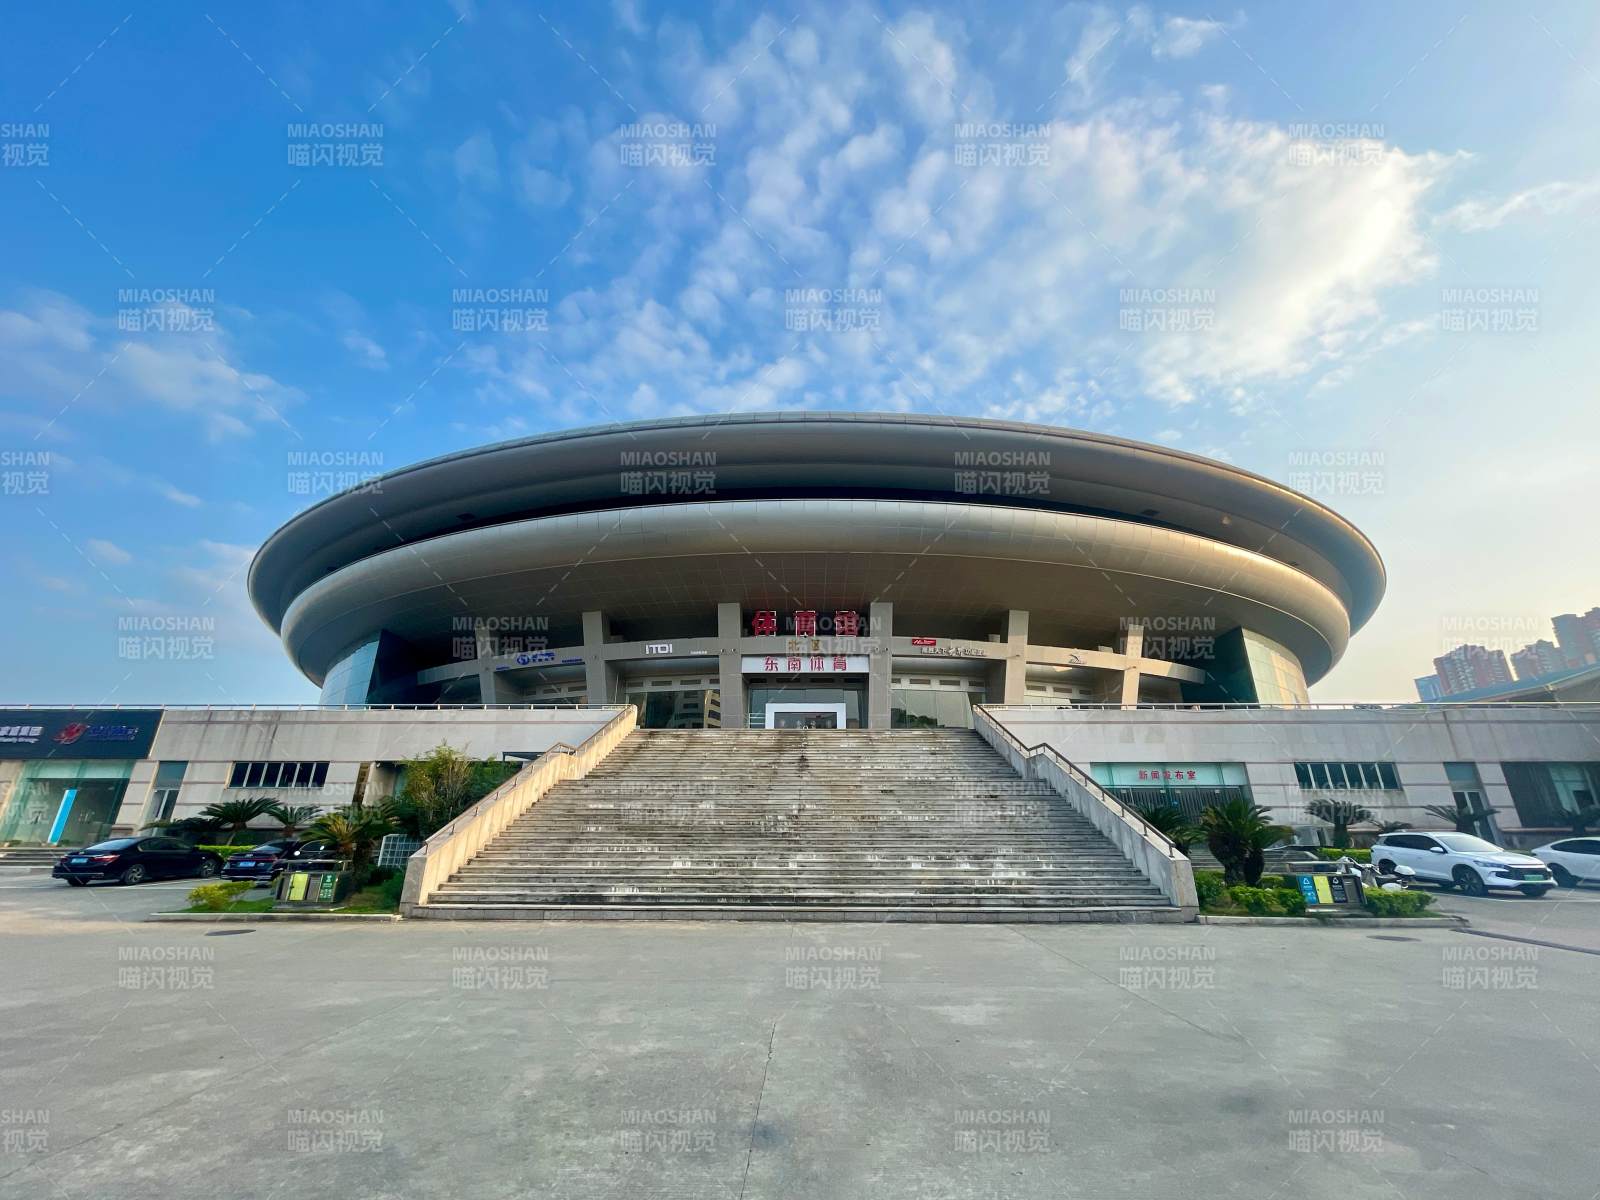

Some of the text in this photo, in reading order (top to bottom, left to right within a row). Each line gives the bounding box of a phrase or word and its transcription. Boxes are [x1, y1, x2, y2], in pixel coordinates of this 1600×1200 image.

[752, 610, 860, 636] 体育馆
[764, 656, 847, 671] 东南体育
[1138, 769, 1196, 780] 新闻发布室
